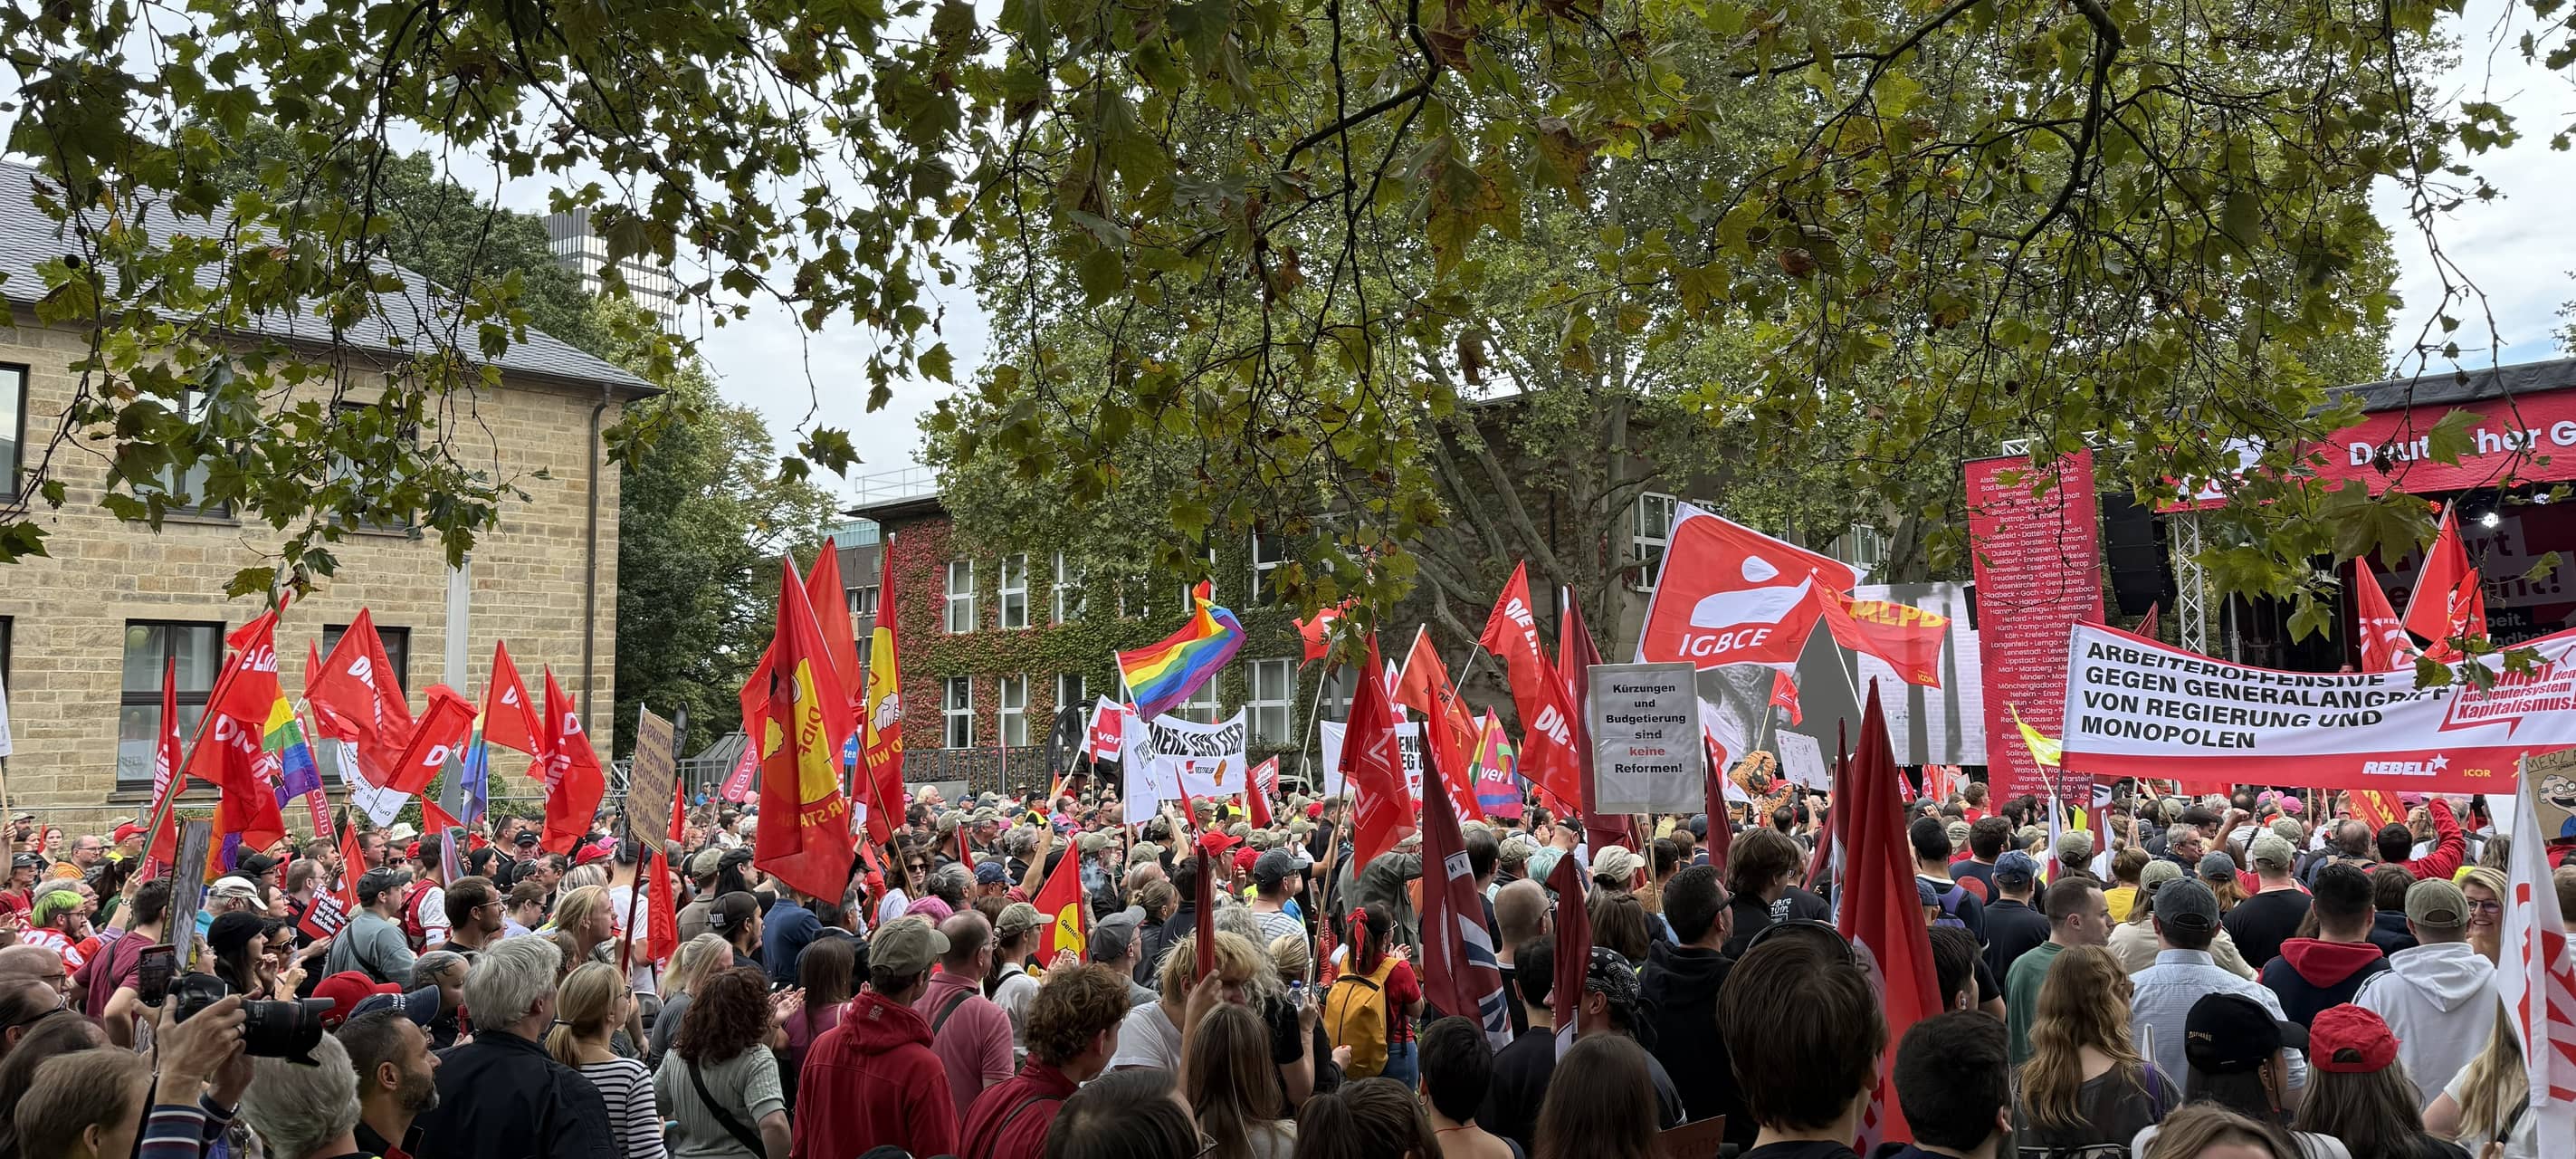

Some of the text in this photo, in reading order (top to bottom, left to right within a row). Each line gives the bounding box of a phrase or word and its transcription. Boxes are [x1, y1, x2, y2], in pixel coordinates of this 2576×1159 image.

[2350, 427, 2541, 466] Duther
[1849, 600, 1948, 628] MLPD
[1678, 627, 1772, 656] IGBCE
[2086, 642, 2385, 687] ARBEITEROFFENSIVE
[1613, 684, 1675, 694] Kürzungen
[2085, 666, 2177, 694] GEGEN
[2084, 690, 2382, 727] VON REGIERUNG UND
[1607, 714, 1686, 724] Budgetierung
[1635, 730, 1662, 739] sind
[2082, 715, 2256, 749] MONOPOLEN
[1629, 747, 1665, 756] keine
[1615, 763, 1683, 773] Reformen!
[2362, 761, 2438, 776] REBELL
[2464, 769, 2492, 778] ICOR
[312, 891, 344, 910] reicht!
